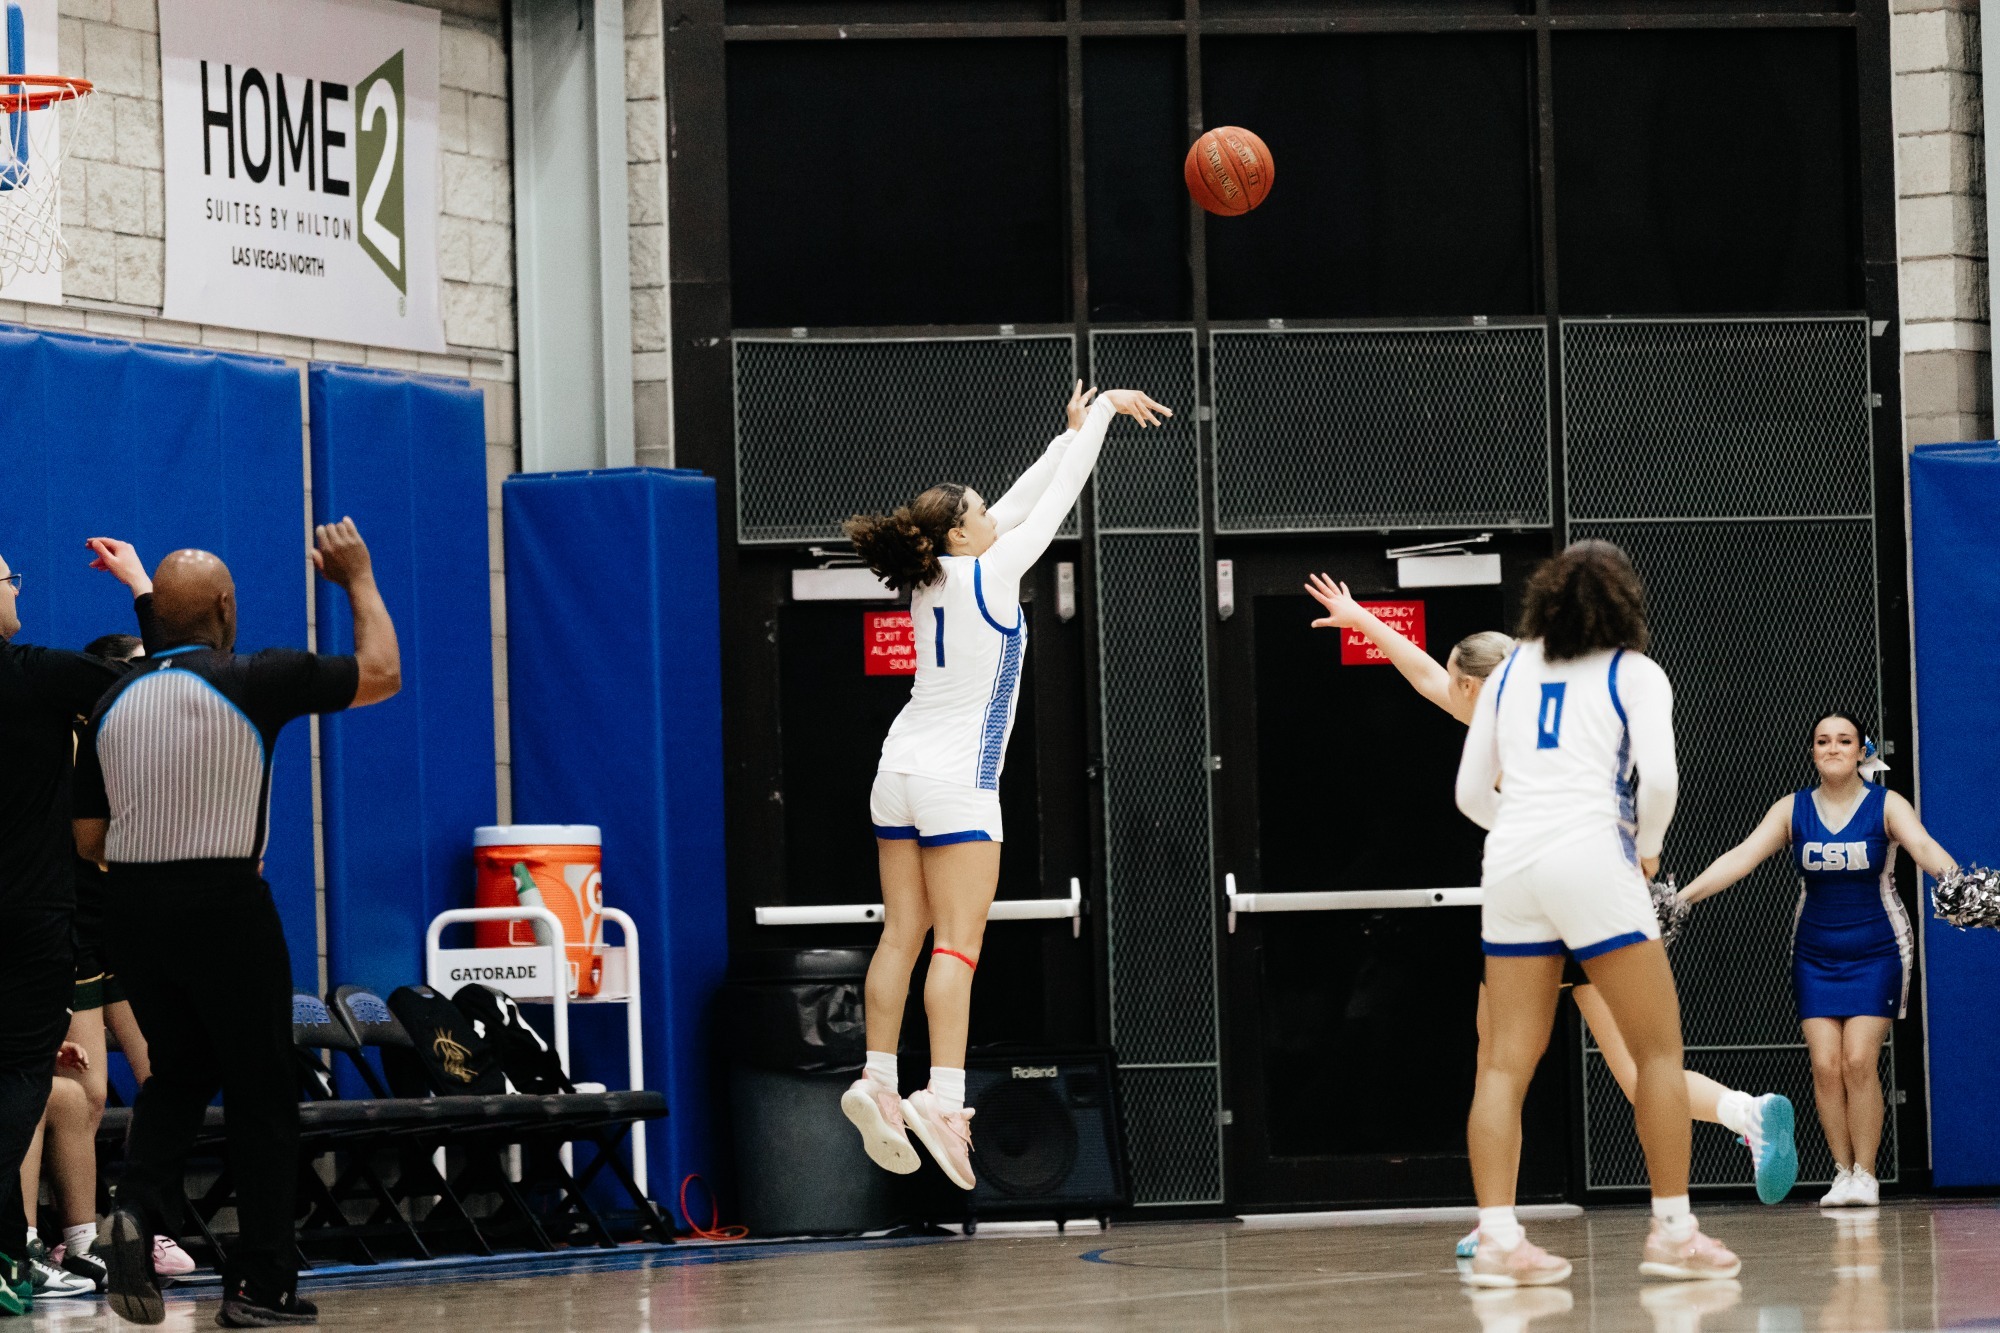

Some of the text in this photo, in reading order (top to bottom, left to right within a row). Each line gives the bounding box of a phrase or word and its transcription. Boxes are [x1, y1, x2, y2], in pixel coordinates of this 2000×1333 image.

[206, 198, 351, 241] SUITES BY HILTON
[232, 246, 325, 277] LAS VEGAS NORTH
[1366, 606, 1416, 617] RGENCY
[873, 617, 913, 628] EMERG
[876, 631, 901, 642] EXIT
[933, 607, 945, 667] 1
[1348, 635, 1373, 646] ALA
[871, 645, 911, 656] ALARM
[889, 659, 916, 670] SOUN
[1537, 682, 1567, 750] 0
[1802, 841, 1870, 871] CSN
[450, 966, 537, 981] GATORADE
[1011, 1066, 1058, 1079] Roland
